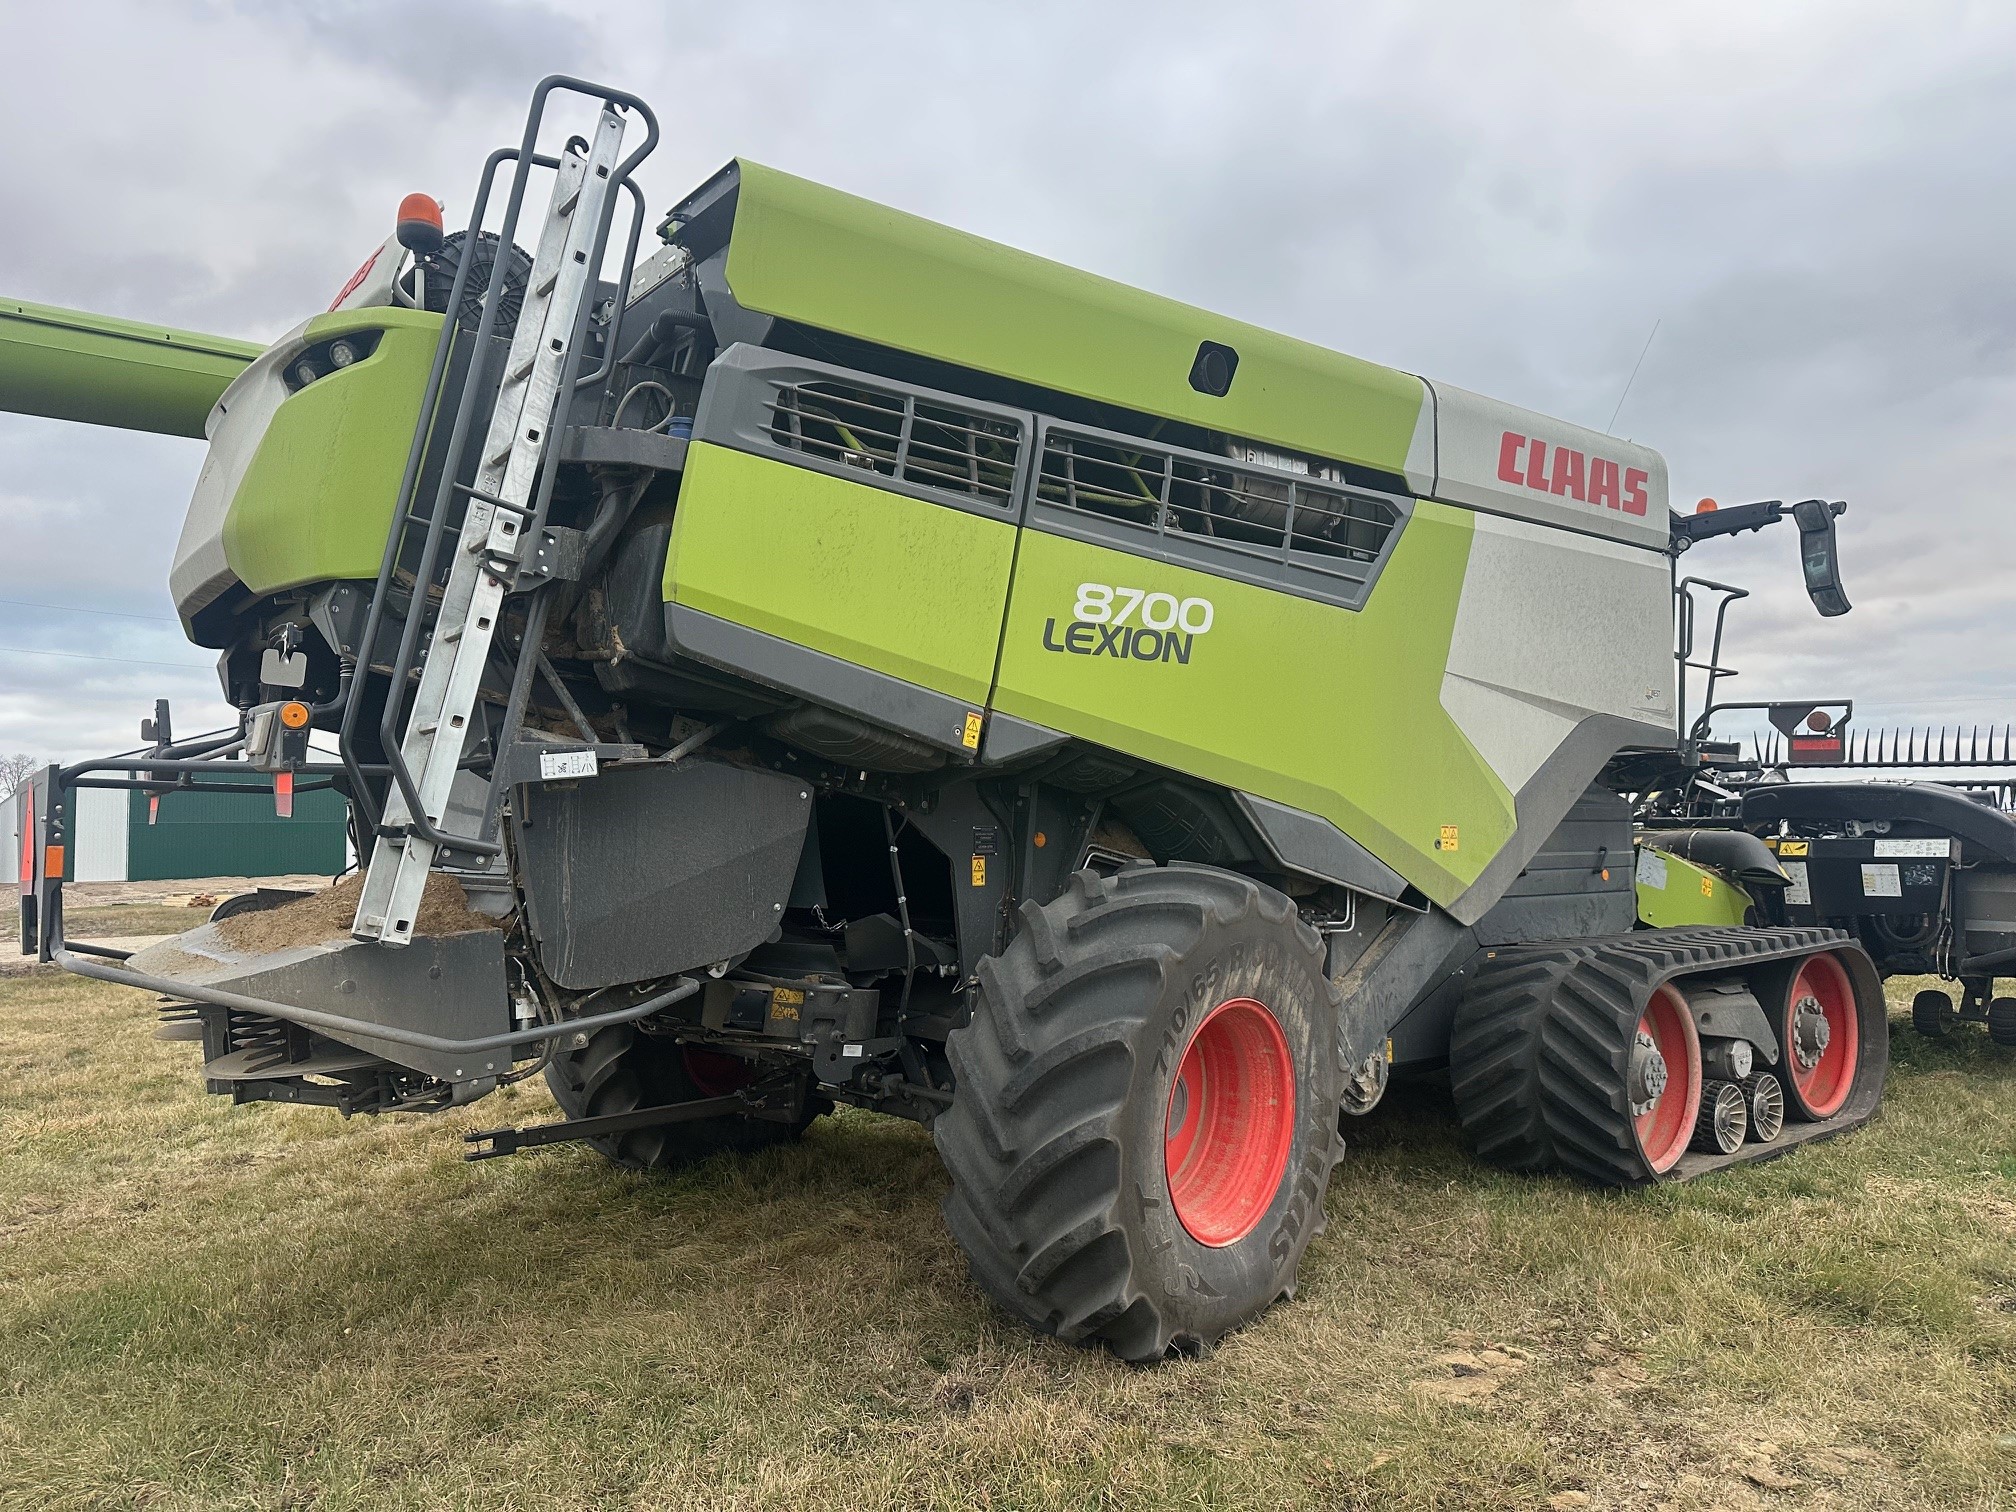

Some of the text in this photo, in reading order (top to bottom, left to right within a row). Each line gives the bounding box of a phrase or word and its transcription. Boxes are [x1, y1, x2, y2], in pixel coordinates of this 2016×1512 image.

[1498, 431, 1648, 517] CLAAS
[1073, 582, 1214, 635] 8700
[1042, 617, 1194, 665] LEXION
